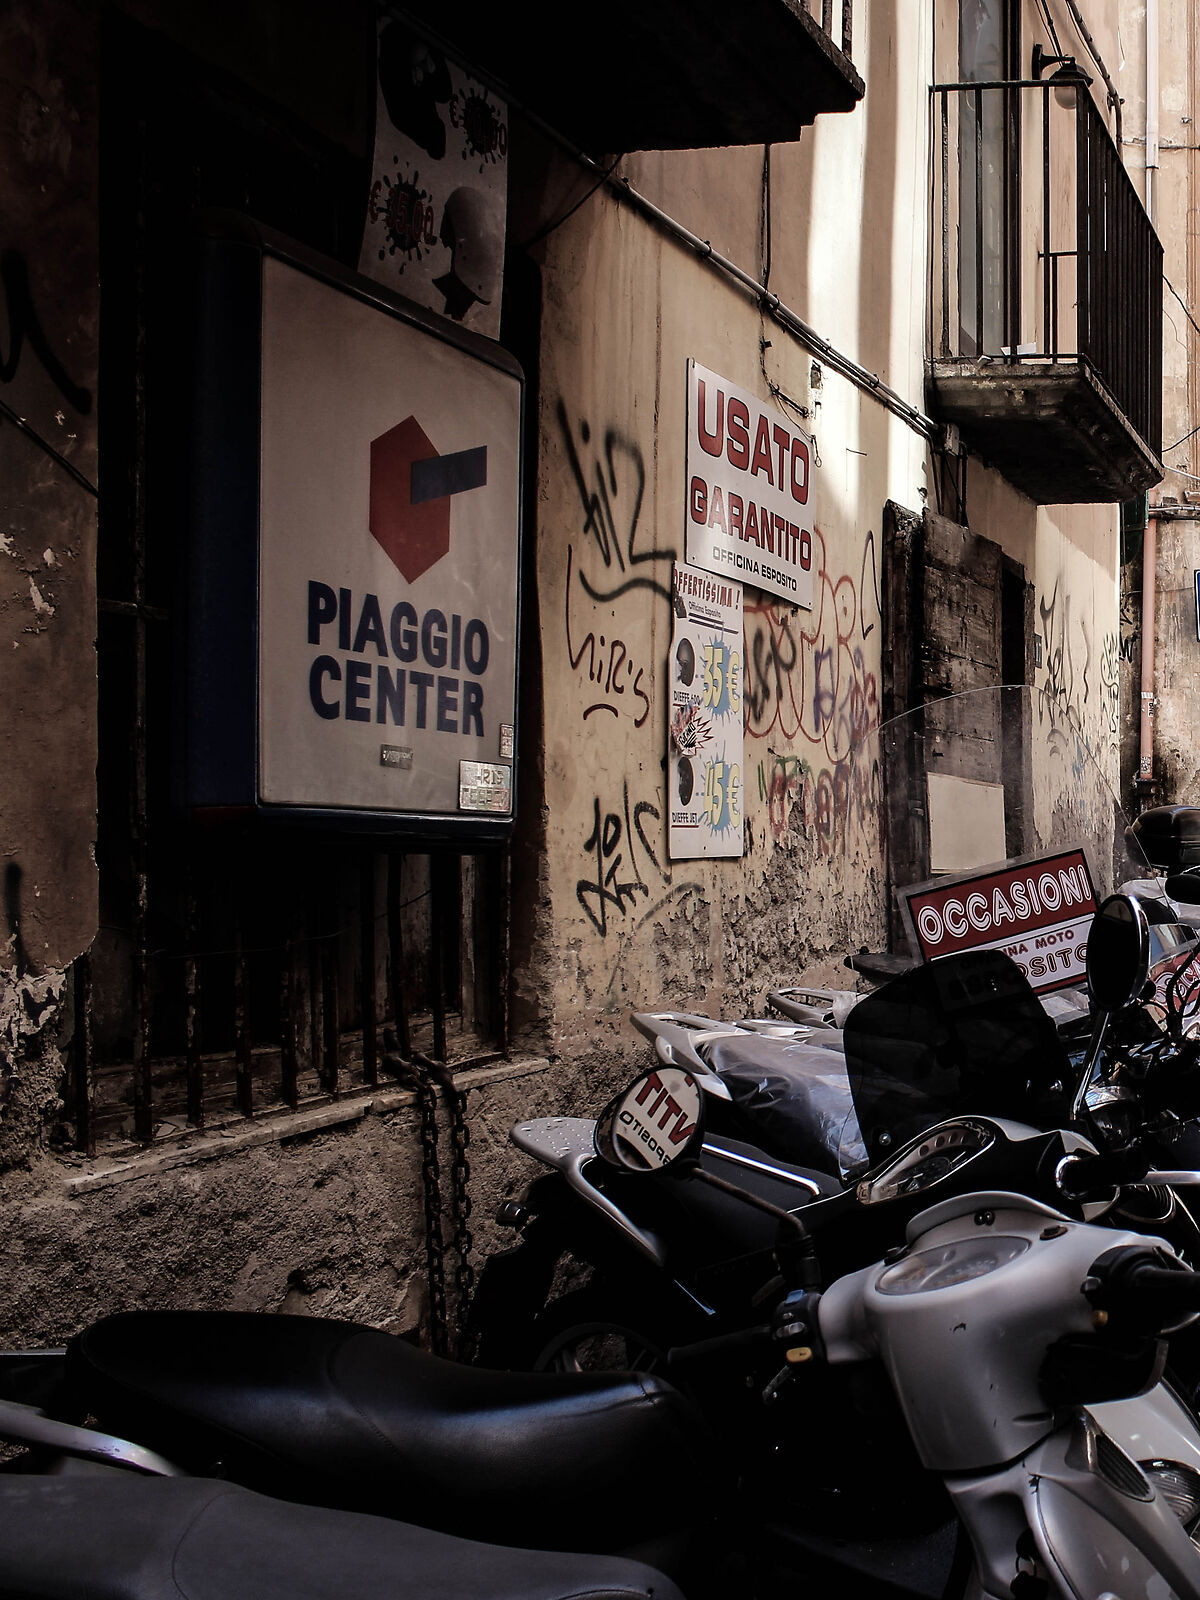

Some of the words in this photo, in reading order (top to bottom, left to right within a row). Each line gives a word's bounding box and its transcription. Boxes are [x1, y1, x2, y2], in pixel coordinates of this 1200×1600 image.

[697, 378, 810, 506] USATO
[690, 475, 812, 572] GARANTITO
[712, 546, 760, 574] OFFICINA
[761, 564, 797, 592] ESPOSITO
[307, 579, 490, 676] PIAGGIO
[308, 654, 485, 738] CENTER
[917, 864, 1092, 945] OCCASIONI
[1035, 929, 1075, 950] MOTO
